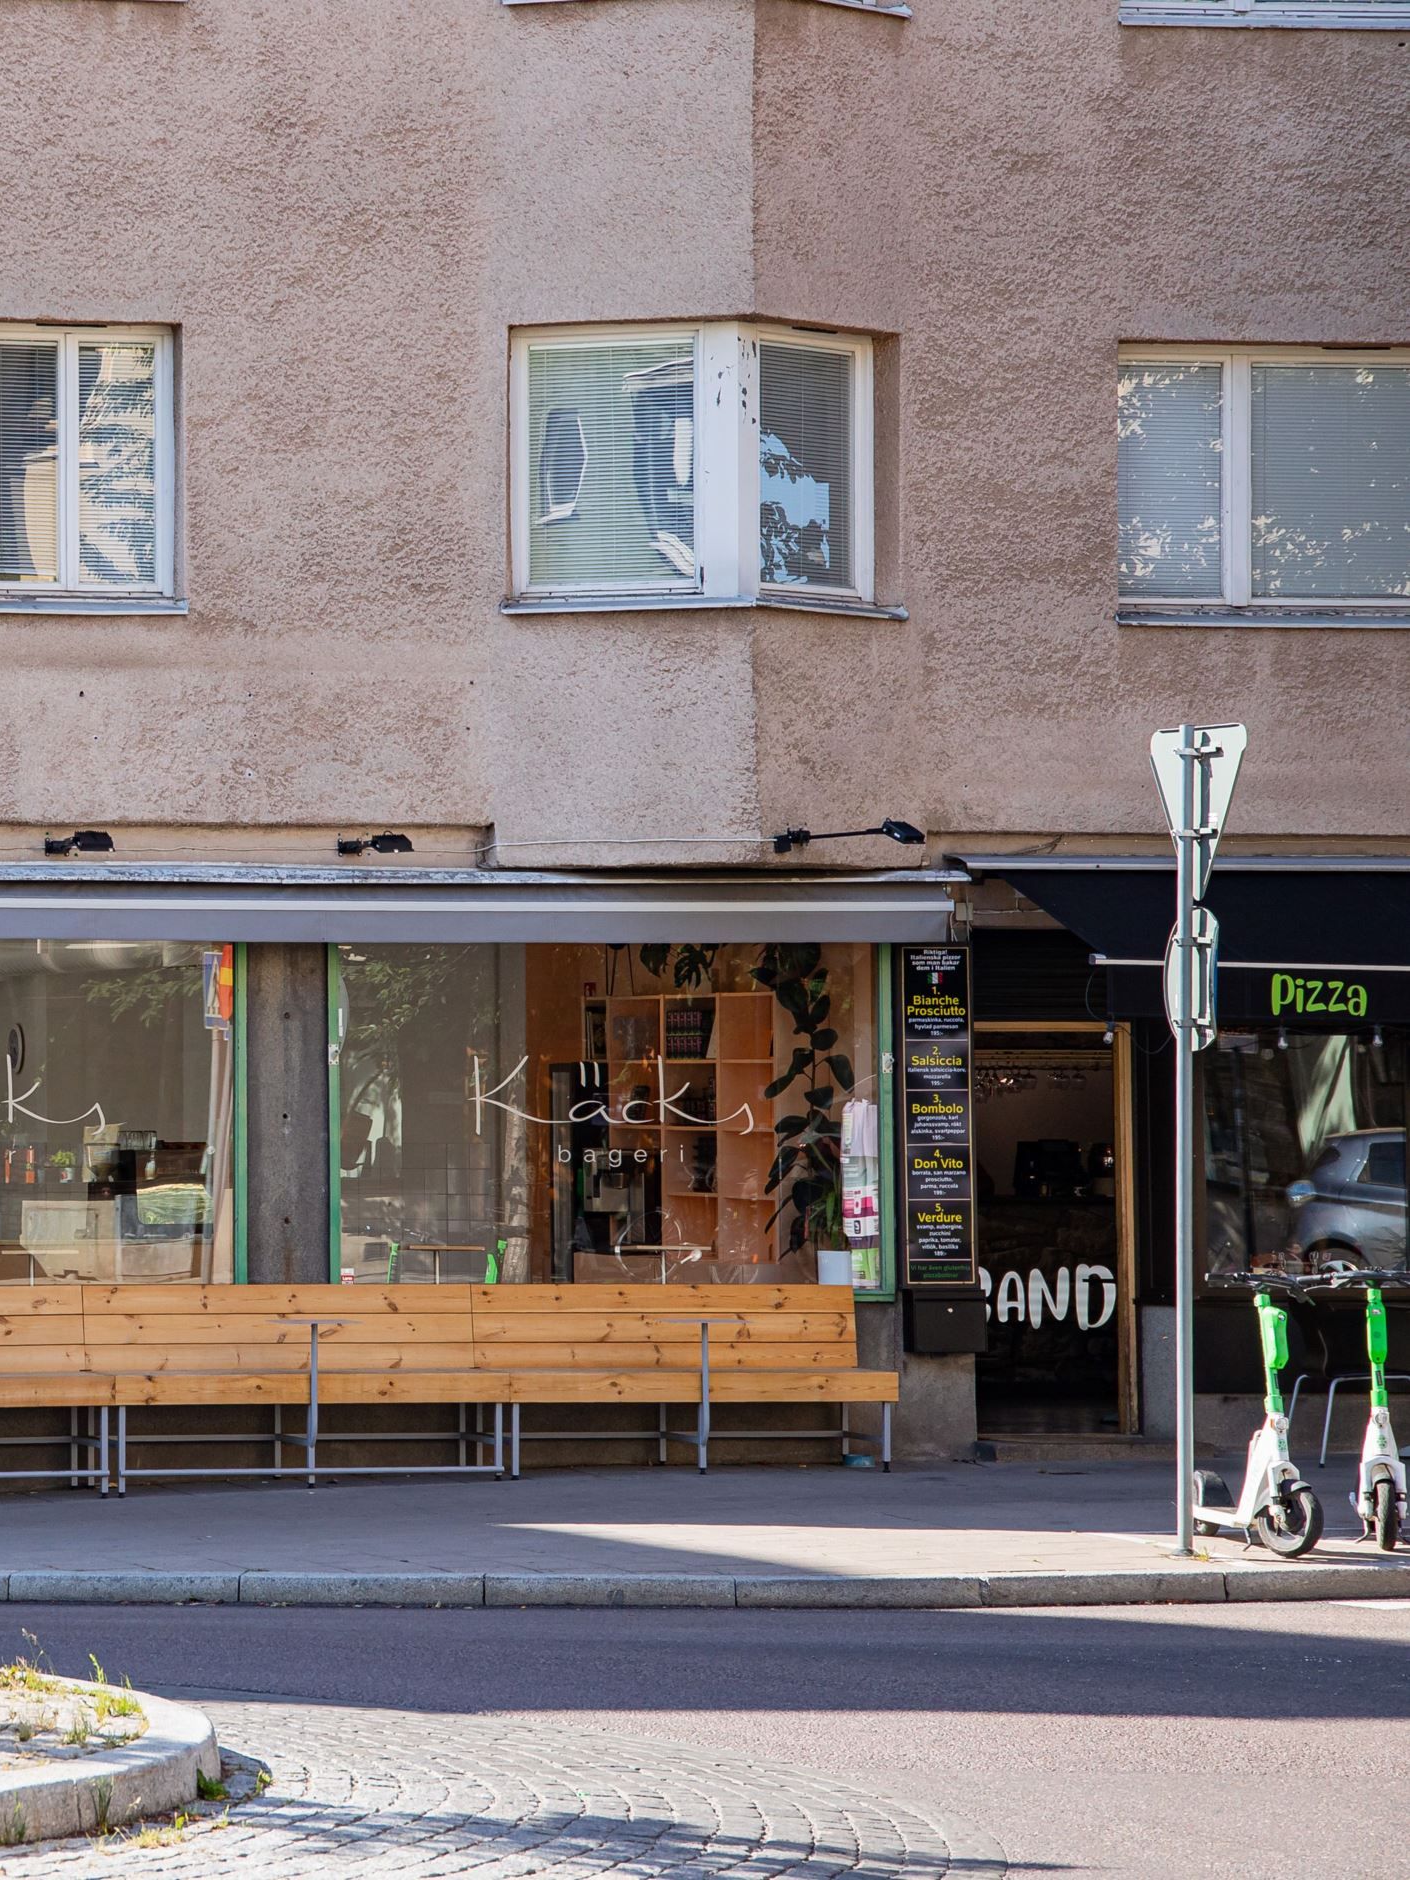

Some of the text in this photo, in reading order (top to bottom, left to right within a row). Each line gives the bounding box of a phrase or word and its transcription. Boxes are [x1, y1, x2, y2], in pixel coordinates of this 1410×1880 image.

[931, 986, 941, 995] 1.
[1271, 973, 1367, 1017] Pizza
[913, 995, 959, 1006] Bianche
[907, 1005, 966, 1016] Prosciutto
[932, 1046, 941, 1056] 2.
[911, 1055, 962, 1066] Salsiccia
[932, 1093, 942, 1103] 3.
[912, 1103, 964, 1114] Bombolo
[558, 1144, 685, 1168] bageri
[933, 1149, 943, 1158] 4.
[914, 1158, 964, 1169] Don Vito
[934, 1203, 945, 1212] 5.
[917, 1212, 963, 1223] Verdure
